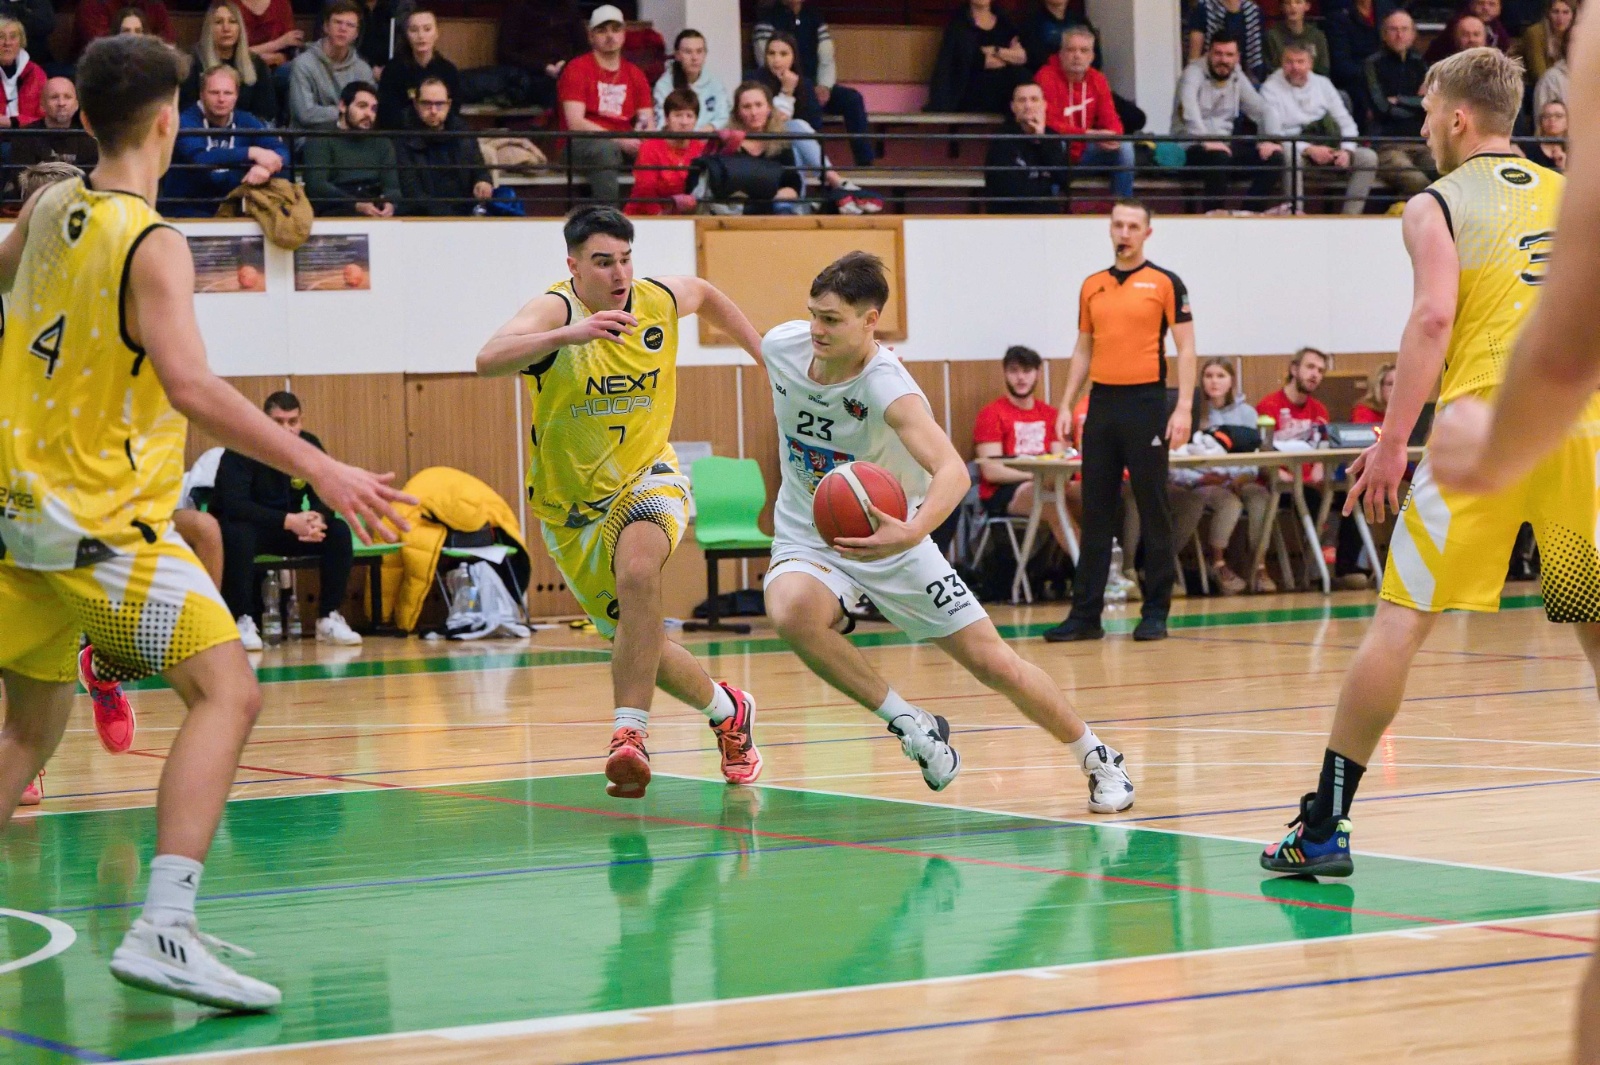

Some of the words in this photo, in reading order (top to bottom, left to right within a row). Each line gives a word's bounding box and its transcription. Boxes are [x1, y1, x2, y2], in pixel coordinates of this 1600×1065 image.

[29, 313, 66, 379] 4
[585, 367, 661, 395] NEXT
[570, 395, 653, 418] HOOP
[608, 425, 627, 446] 7
[796, 410, 835, 442] 23
[926, 573, 967, 609] 23
[947, 600, 972, 617] SPALDING
